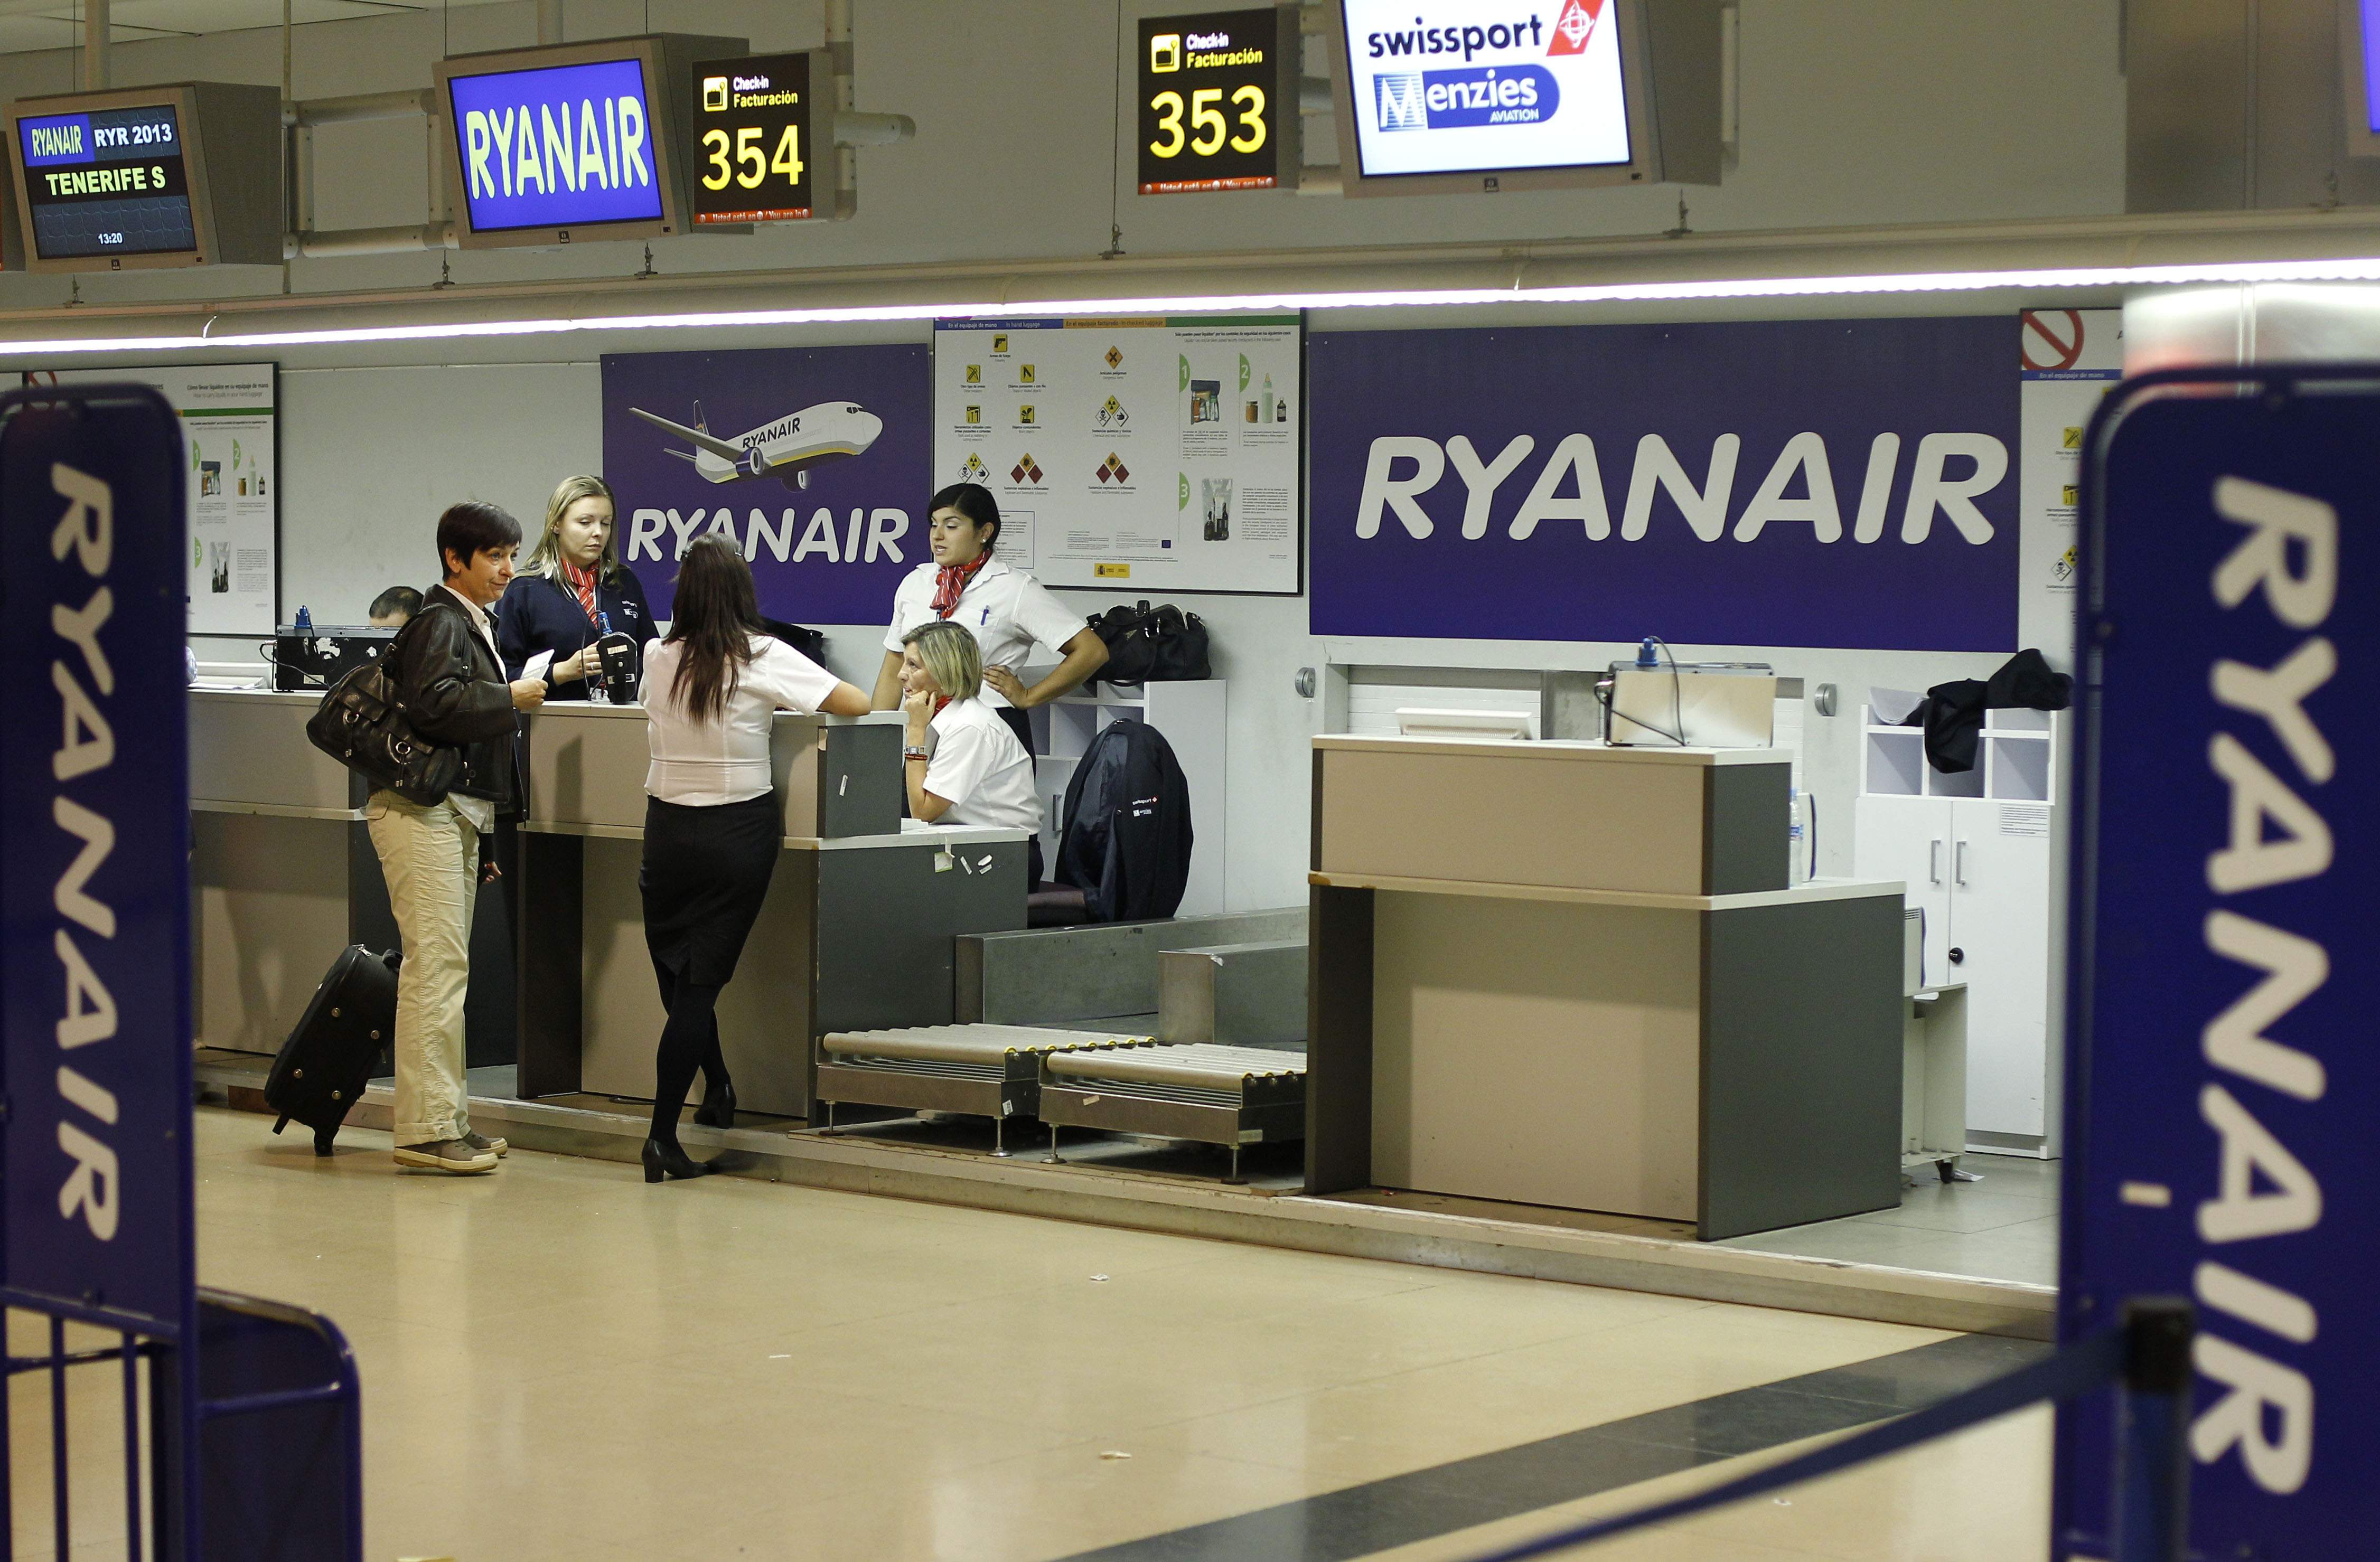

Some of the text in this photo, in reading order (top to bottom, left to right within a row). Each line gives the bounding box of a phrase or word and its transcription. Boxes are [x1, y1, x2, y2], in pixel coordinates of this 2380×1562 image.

[1186, 32, 1229, 50] Check-in
[1368, 14, 1543, 62] swissport
[1187, 48, 1262, 68] Facturación
[733, 75, 769, 90] Check-in
[734, 90, 798, 108] Facturación
[1379, 69, 1538, 128] Menzies
[1150, 85, 1266, 158] 353
[1489, 108, 1539, 123] AVIATION
[31, 125, 83, 157] RYANAIR
[94, 124, 172, 148] RYR 2013
[466, 96, 649, 200] RYANAIR
[702, 125, 803, 191] 354
[45, 166, 165, 195] TENERIFE S
[713, 213, 731, 222] Usted
[769, 210, 781, 219] You
[98, 233, 123, 244] 13:20
[1182, 365, 1187, 379] 1
[1241, 364, 1248, 379] 2
[743, 417, 801, 448] RYANAIR
[1181, 484, 1188, 497] 3
[1355, 431, 2008, 545] RYANAIR
[52, 463, 118, 1241] RYANAIR
[2188, 477, 2337, 1494] RYANAIR
